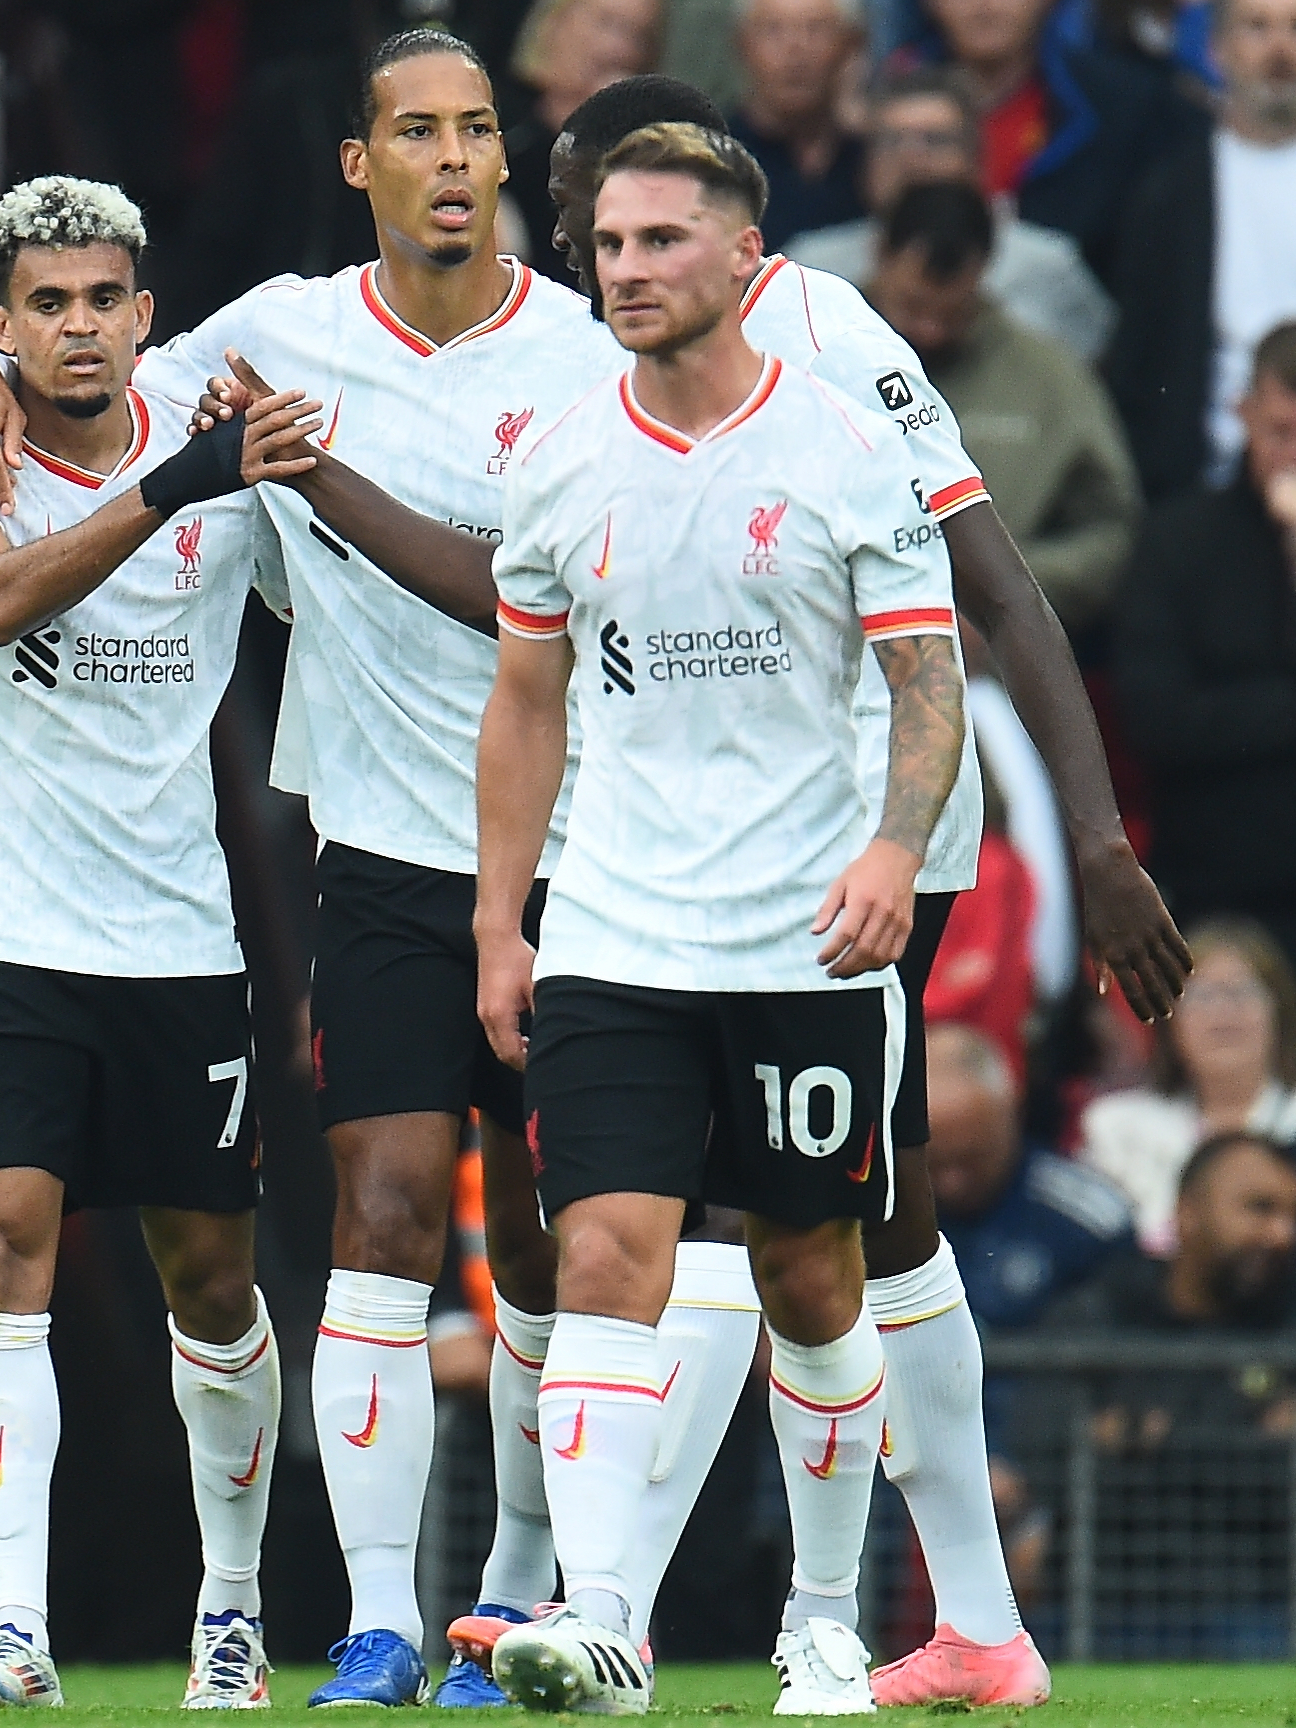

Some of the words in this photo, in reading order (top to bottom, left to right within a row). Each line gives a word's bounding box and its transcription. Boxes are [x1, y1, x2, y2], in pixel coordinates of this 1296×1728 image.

[743, 559, 780, 575] LFC
[175, 574, 201, 591] LFC
[74, 632, 189, 659] standard
[646, 620, 782, 655] standard
[72, 658, 195, 684] chartered
[649, 648, 792, 682] chartered
[207, 1056, 248, 1149] 7
[754, 1063, 852, 1158] 10
